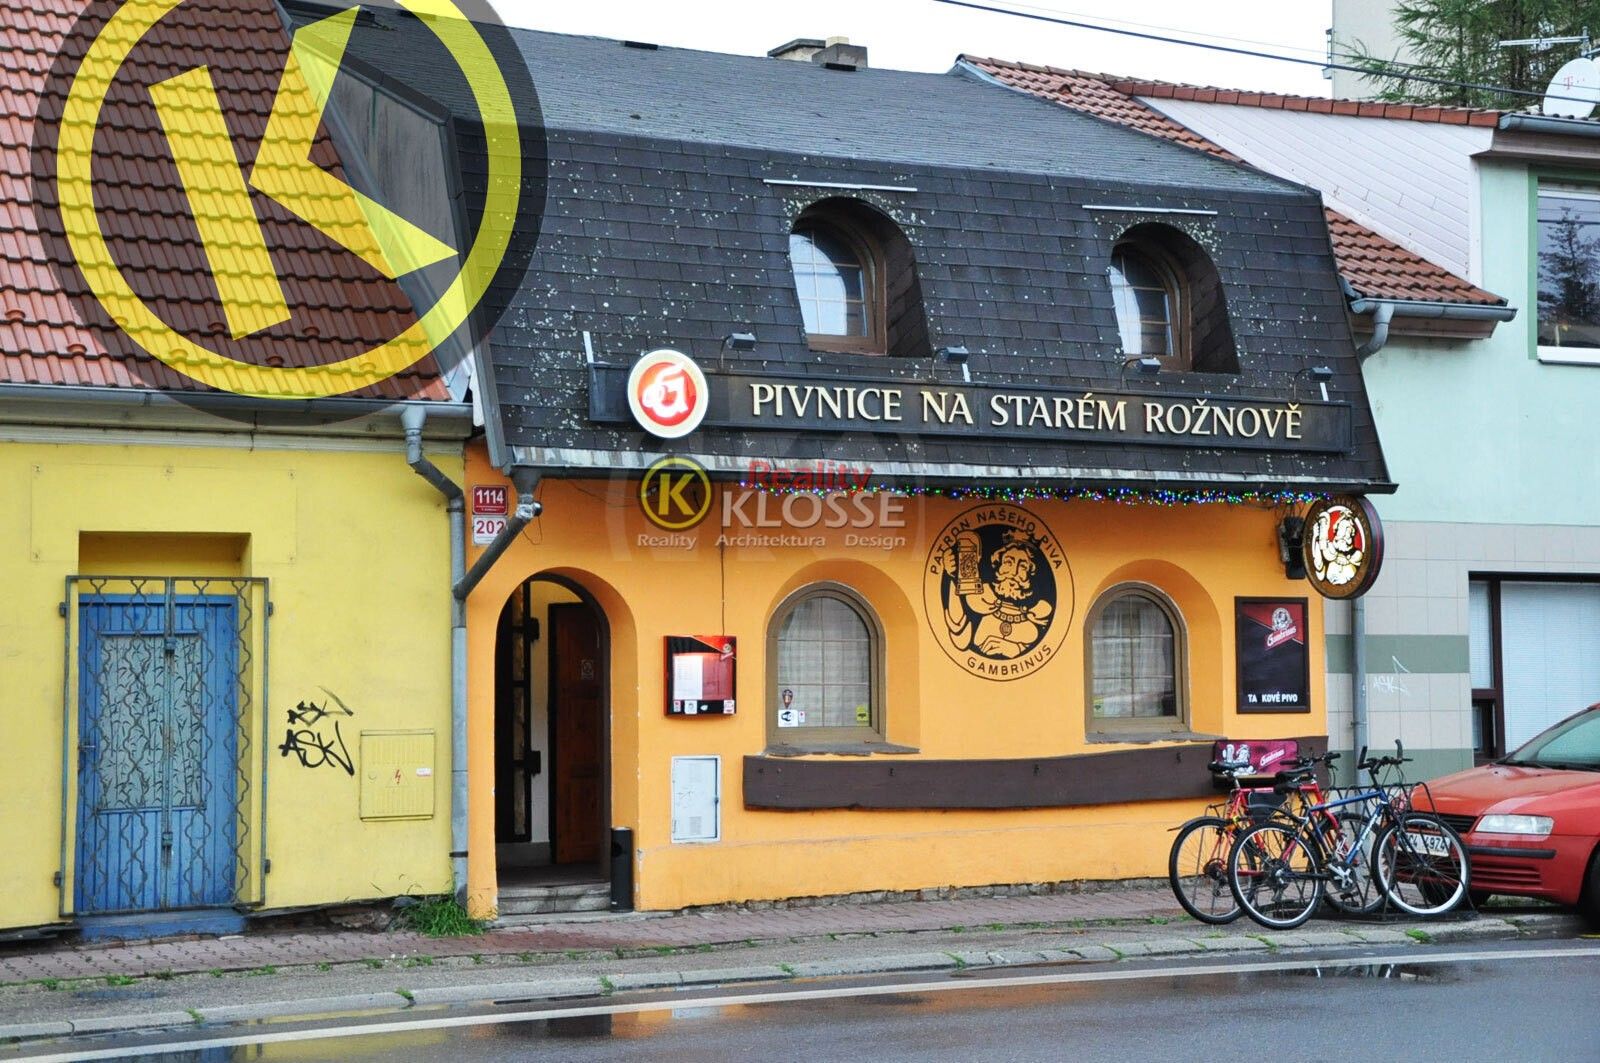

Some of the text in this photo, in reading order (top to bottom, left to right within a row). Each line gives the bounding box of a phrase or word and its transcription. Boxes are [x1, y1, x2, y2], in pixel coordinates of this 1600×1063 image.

[750, 383, 1302, 439] PIVNICE NA STARÉM ROŽNOVĚ
[476, 489, 504, 504] 1114
[931, 508, 1063, 575] PATRON NAŠEHO PIVA
[967, 644, 1052, 675] GAMBRINUS
[1248, 691, 1298, 703] TA KOVÉ PIVO
